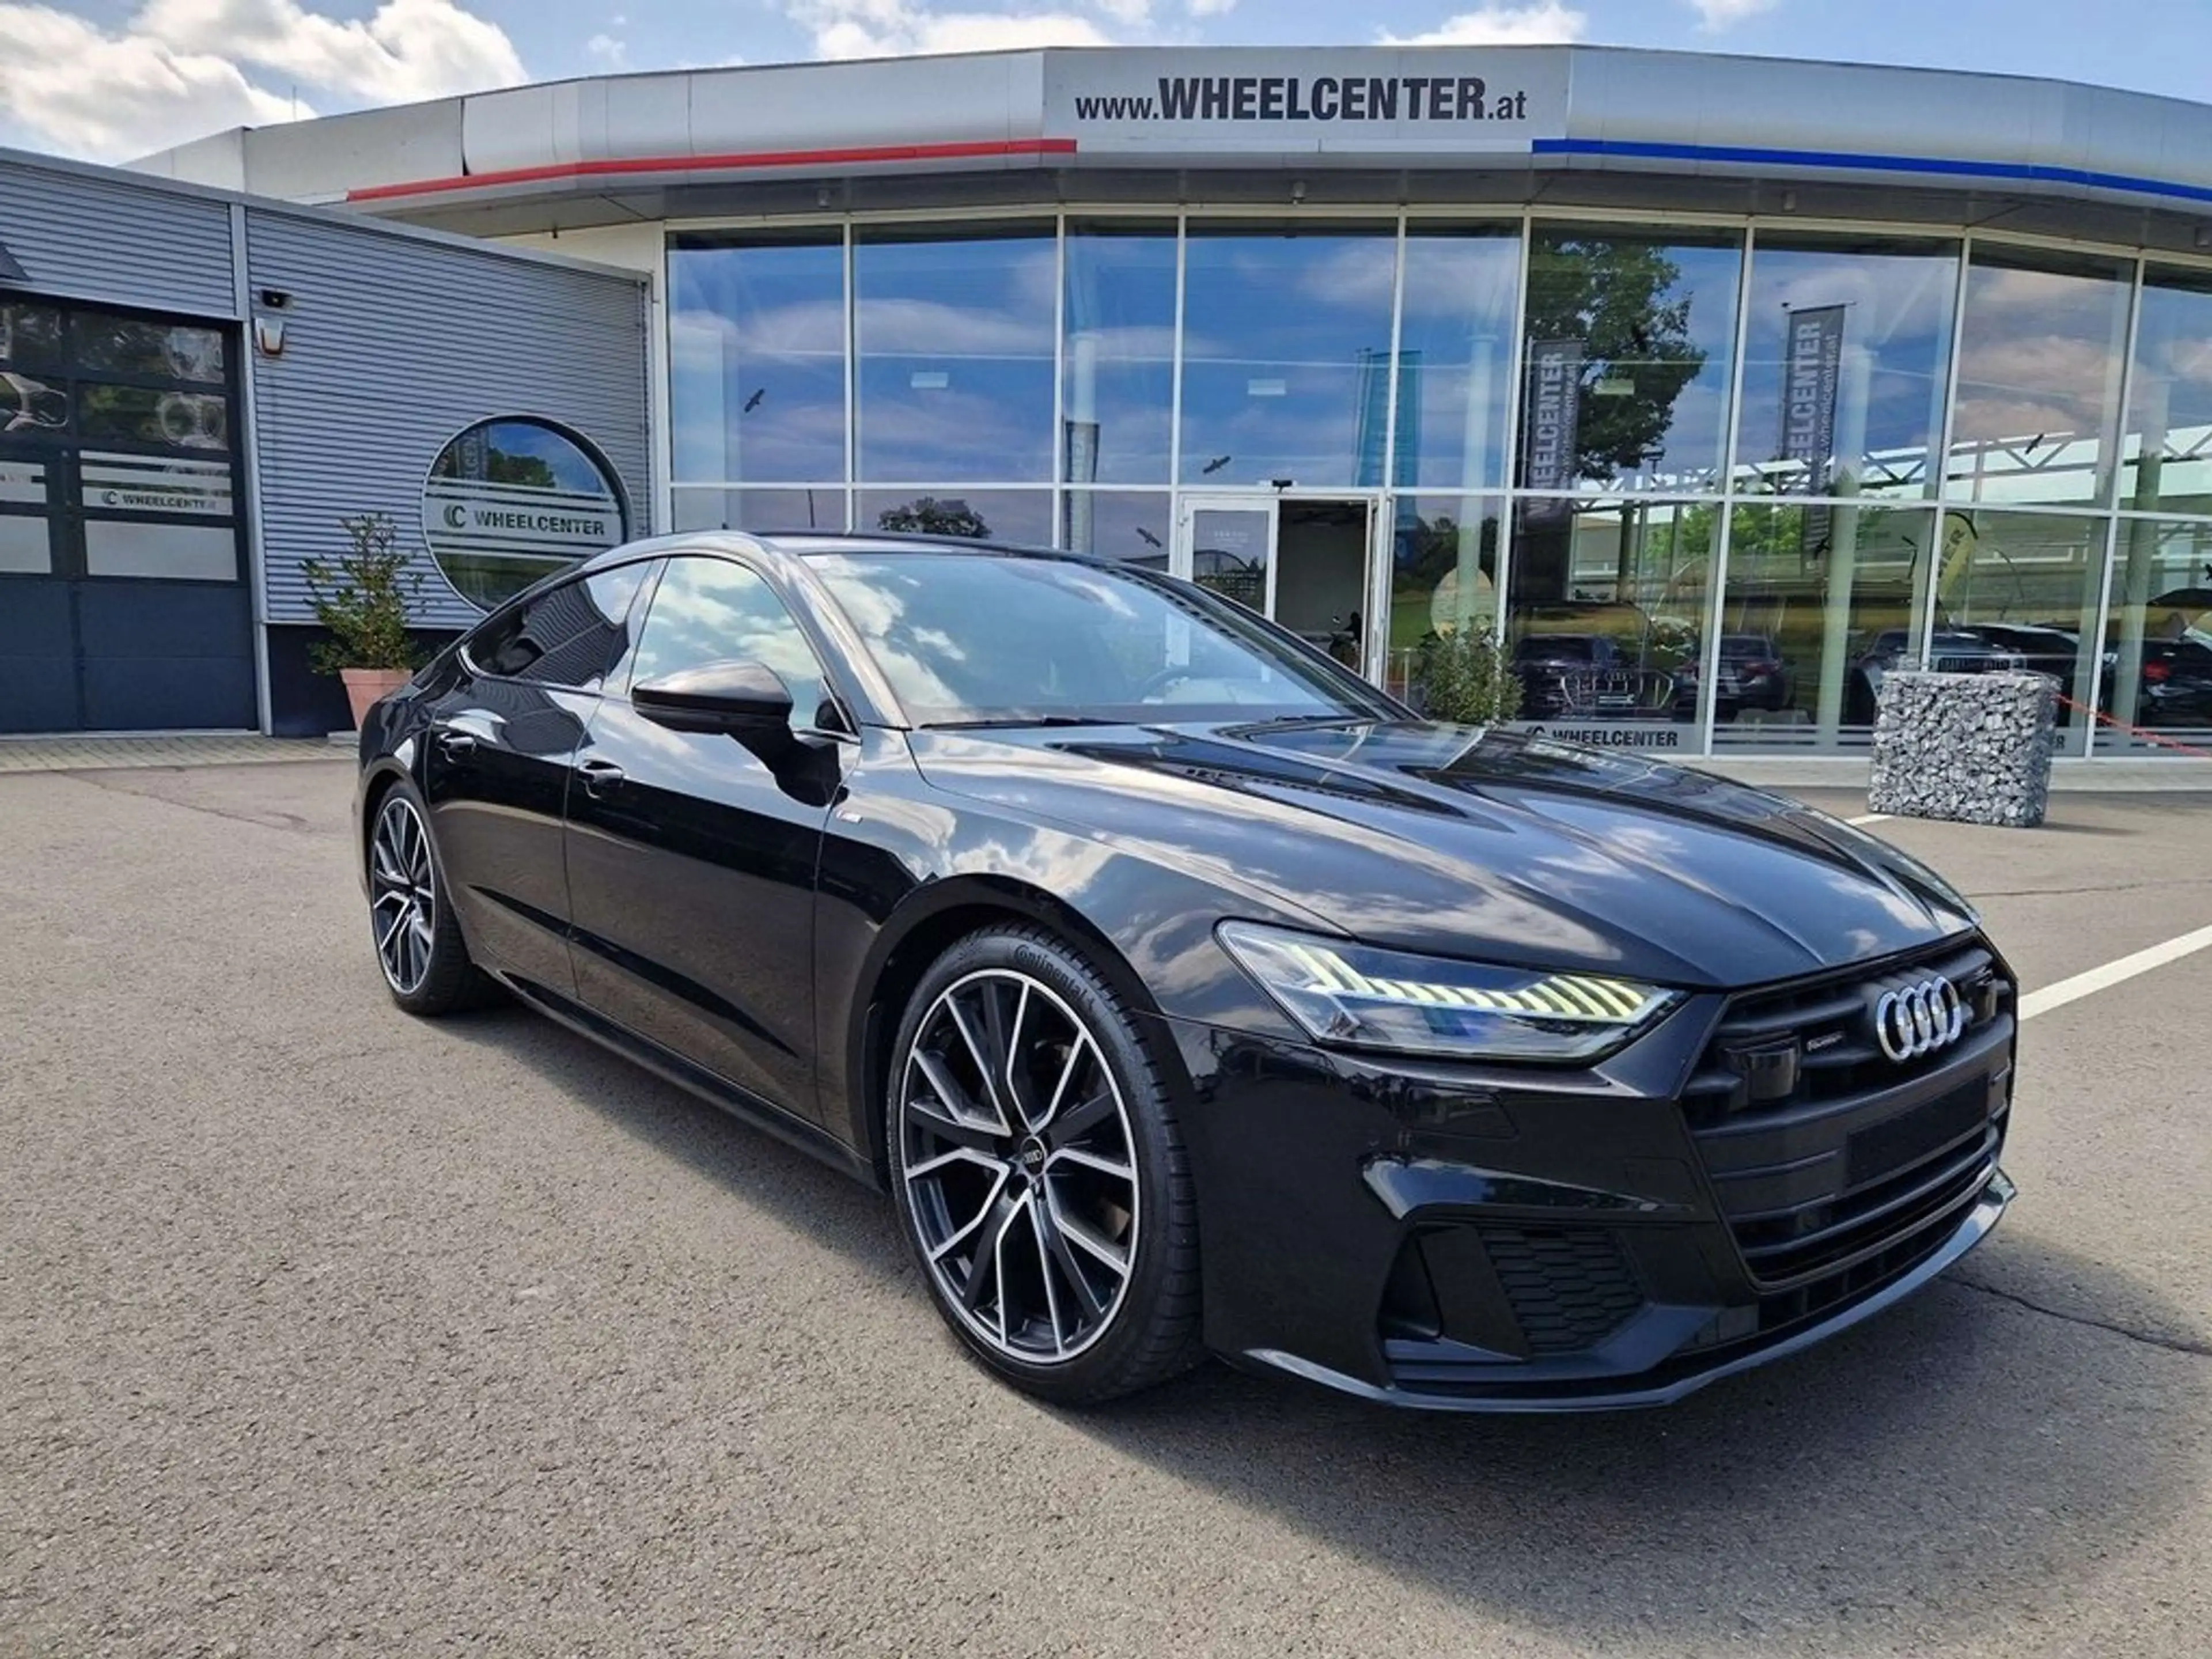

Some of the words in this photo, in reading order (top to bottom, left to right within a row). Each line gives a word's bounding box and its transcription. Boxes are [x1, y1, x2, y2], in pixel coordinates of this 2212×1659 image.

[1075, 77, 1527, 120] www.WHEELCENTER.at
[474, 510, 604, 535] WHEELCENTER
[1552, 729, 1678, 747] WHEELCENTER
[1014, 944, 1088, 999] Continental
